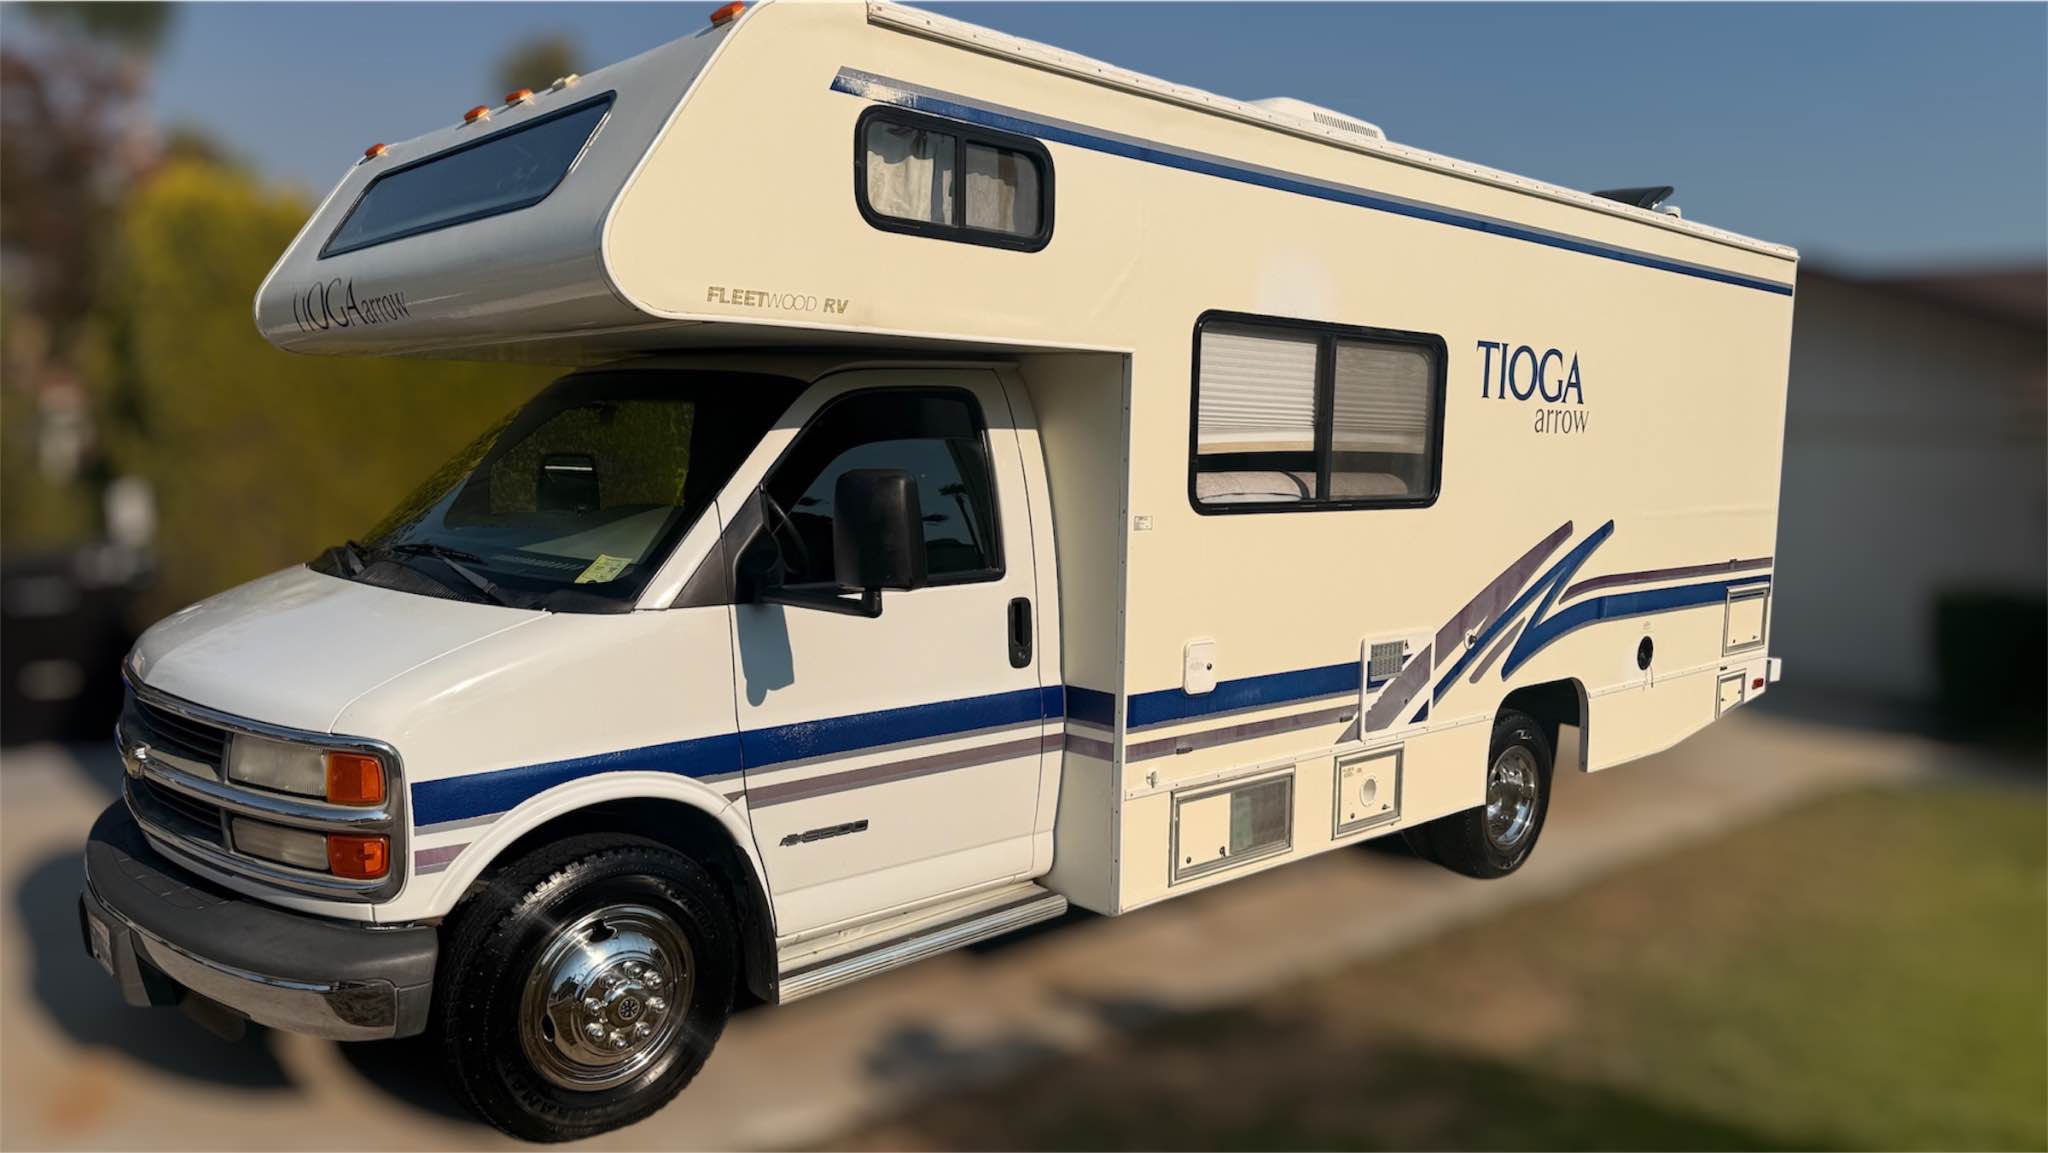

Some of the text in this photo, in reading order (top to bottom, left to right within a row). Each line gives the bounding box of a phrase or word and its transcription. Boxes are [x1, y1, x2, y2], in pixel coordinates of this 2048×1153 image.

[706, 286, 849, 314] FLEETWOOD RV
[1476, 340, 1584, 404] TIOGA
[1534, 408, 1590, 434] arrow
